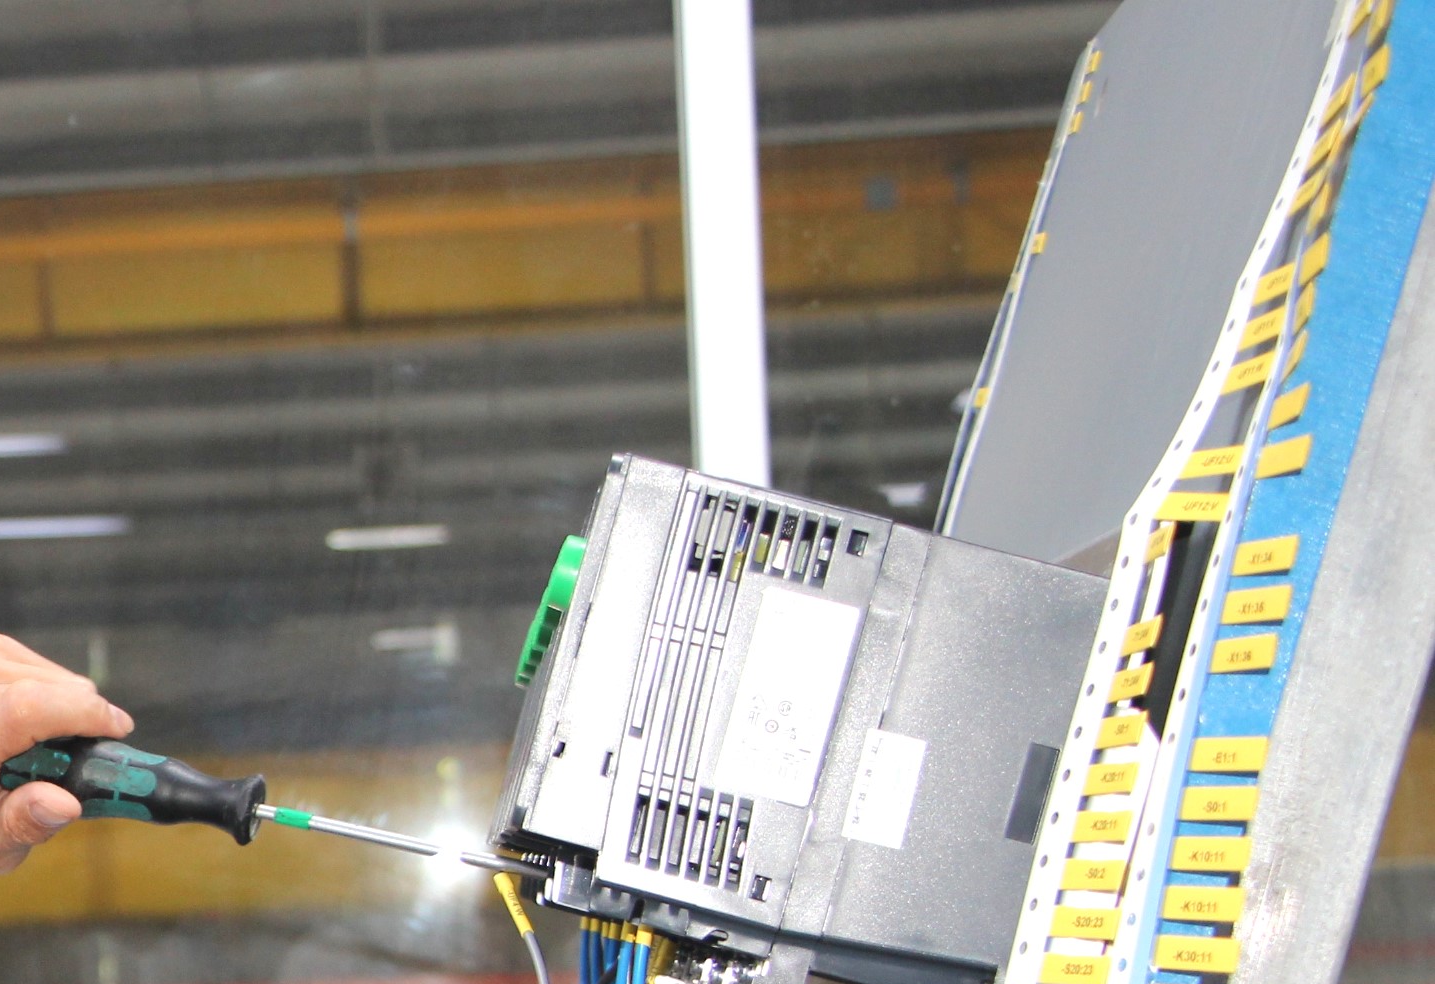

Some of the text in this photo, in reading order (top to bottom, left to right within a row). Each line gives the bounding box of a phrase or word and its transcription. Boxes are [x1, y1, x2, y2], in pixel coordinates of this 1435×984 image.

[1213, 752, 1237, 764] -E1:1
[1203, 801, 1227, 813] -S0:1
[1188, 851, 1226, 862] -K10:11
[1085, 867, 1106, 879] -S0:2
[1180, 902, 1218, 913] -K10:11
[1072, 916, 1105, 928] -S20:23
[1173, 951, 1213, 963] -K30:11
[1061, 963, 1094, 975] -S20:23
